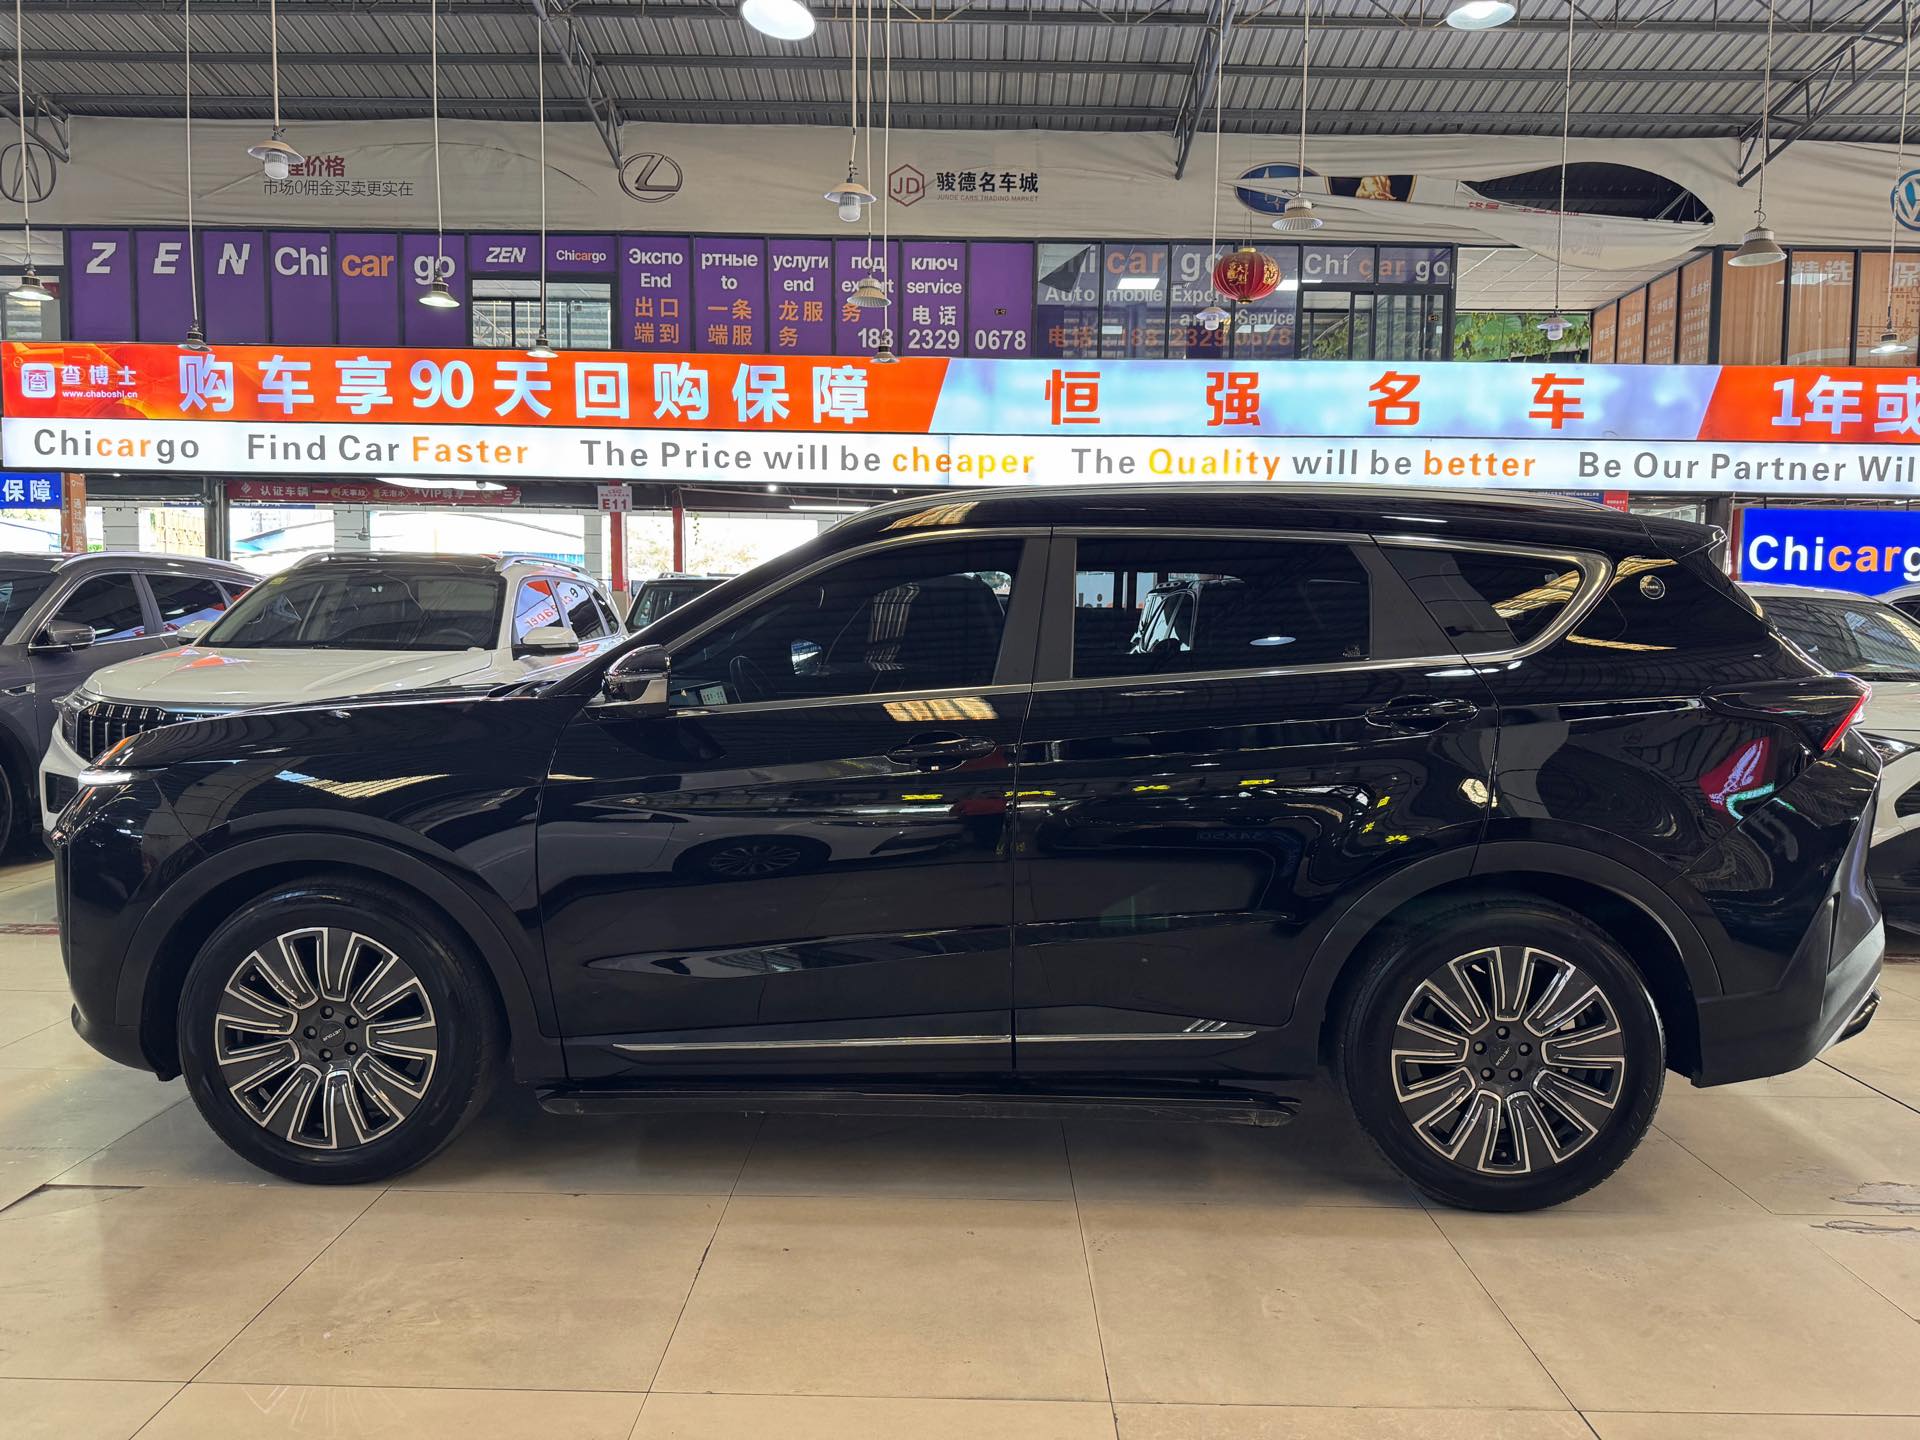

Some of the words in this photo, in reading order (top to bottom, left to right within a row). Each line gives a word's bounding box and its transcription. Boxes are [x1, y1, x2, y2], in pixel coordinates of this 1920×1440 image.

[264, 180, 414, 196] 市场0佣金买卖更实在
[936, 172, 1039, 193] 骏德名车城
[275, 246, 328, 276] Chi
[341, 254, 394, 277] car
[414, 254, 455, 285] go
[485, 247, 527, 263] ZEN
[556, 249, 607, 264] Chicargo
[772, 254, 829, 271] услуги
[851, 256, 886, 272] под
[911, 257, 958, 271] ключ
[1106, 250, 1165, 273] car
[1304, 253, 1350, 275] Chi
[1415, 260, 1449, 280] go
[640, 273, 671, 288] End
[720, 274, 738, 290] to
[783, 277, 814, 292] end
[841, 279, 894, 293] exrt
[906, 279, 962, 294] service
[1045, 289, 1096, 302] Auto
[912, 305, 957, 326] 电话
[908, 329, 960, 350] 2329
[974, 330, 1027, 350] 0678
[61, 364, 137, 386] 查博士
[62, 390, 138, 399] www.chaboshi.cn
[33, 428, 200, 464] Chicargo
[247, 433, 327, 461] Find
[338, 434, 400, 462] Car
[412, 436, 529, 463] Faster
[580, 440, 648, 467] The
[661, 442, 752, 469] Price
[763, 444, 828, 470] will
[840, 445, 881, 471] be
[892, 446, 1035, 479] cheaper
[1071, 447, 1136, 474] The
[1149, 447, 1281, 480] Quality
[1292, 449, 1358, 475] will
[1370, 449, 1412, 475] be
[1423, 450, 1536, 477] better
[1578, 451, 1621, 478] Be
[1633, 451, 1699, 479] Our
[1710, 453, 1847, 481] Partner
[2, 479, 51, 503] 保障
[260, 485, 309, 497] 认证车辆
[602, 499, 627, 510] E11
